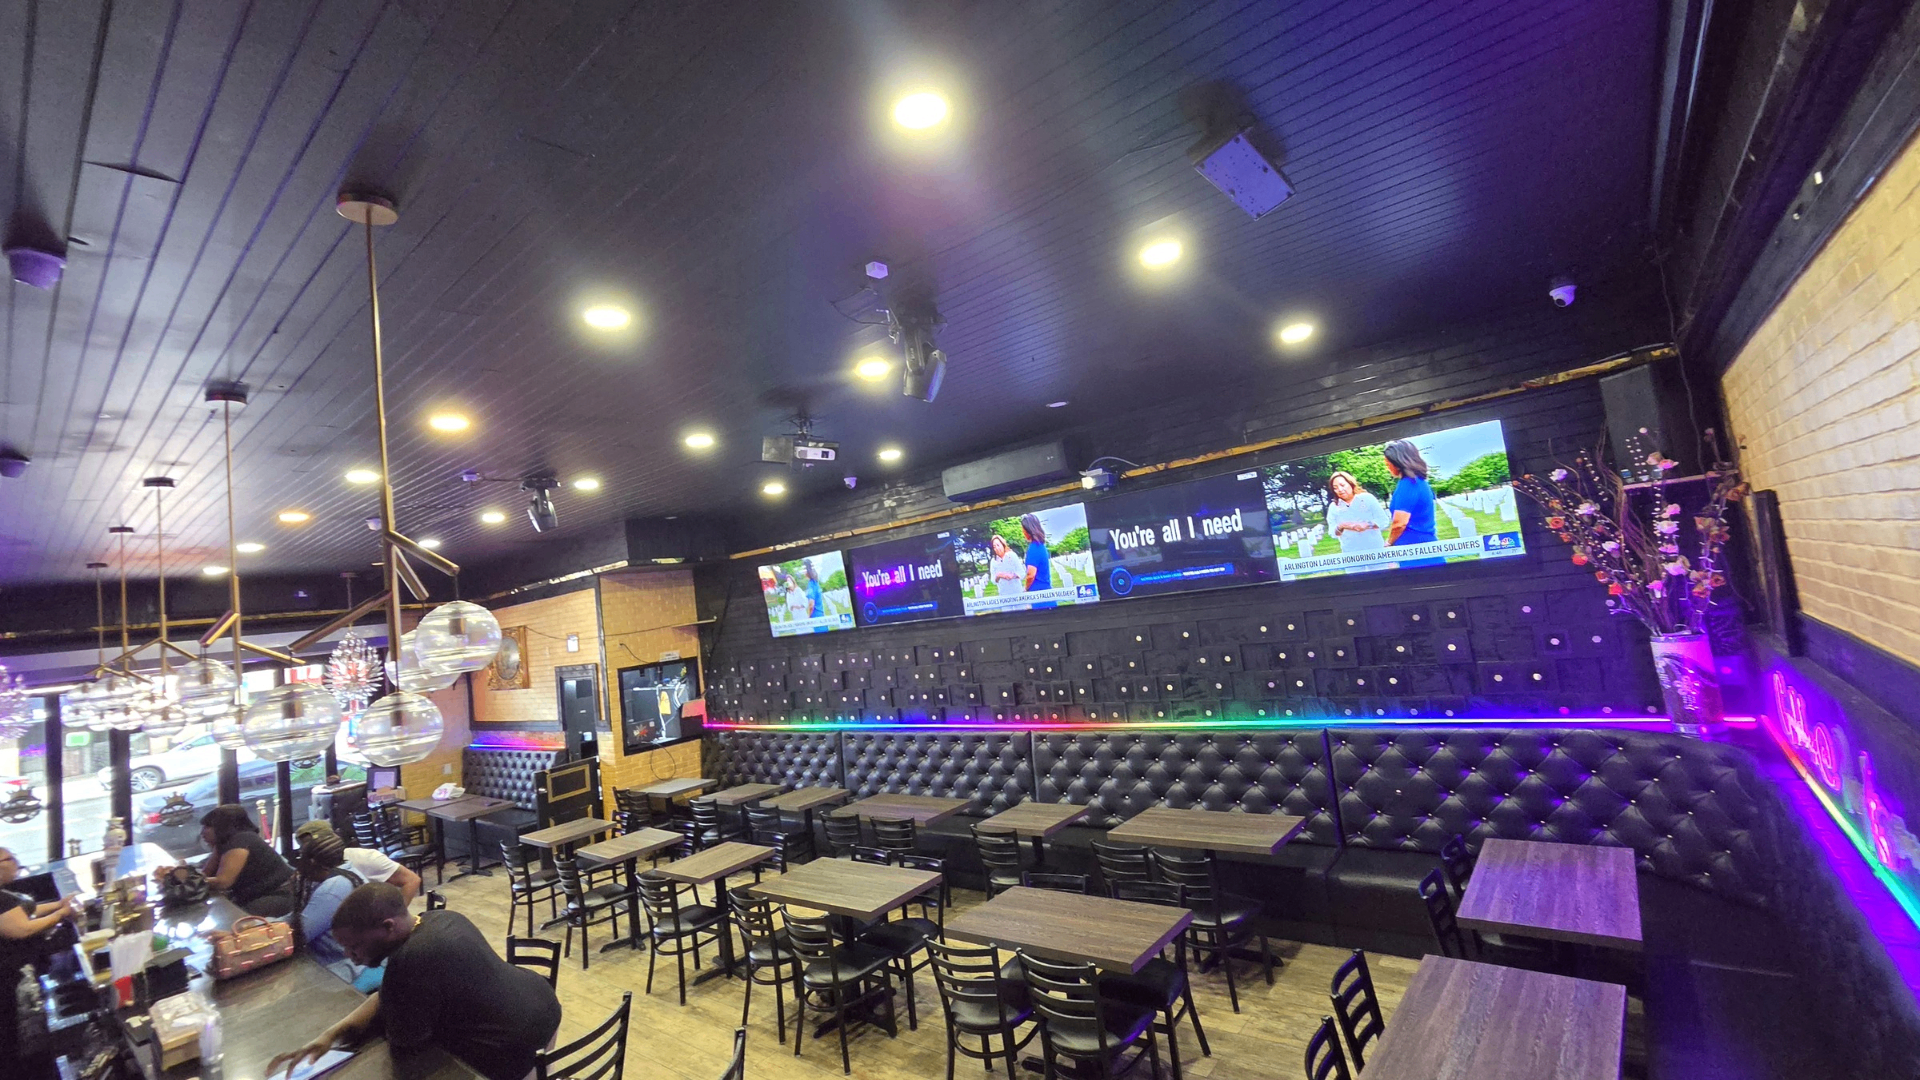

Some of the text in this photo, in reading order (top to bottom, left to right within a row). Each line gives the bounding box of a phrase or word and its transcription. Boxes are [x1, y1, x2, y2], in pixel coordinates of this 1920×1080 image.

[1109, 508, 1243, 550] You're all I need
[1488, 534, 1500, 546] 4
[1284, 560, 1318, 571] ARLINGTON
[1319, 557, 1341, 567] LADIES
[1342, 553, 1376, 564] HONORING
[1377, 548, 1414, 559] AMERICA'S
[1415, 545, 1442, 556] FALLEN
[1444, 540, 1480, 552] SOLDIERS
[862, 559, 943, 588] You're all I need
[1039, 591, 1055, 600] FALLEN
[1079, 586, 1086, 595] 4
